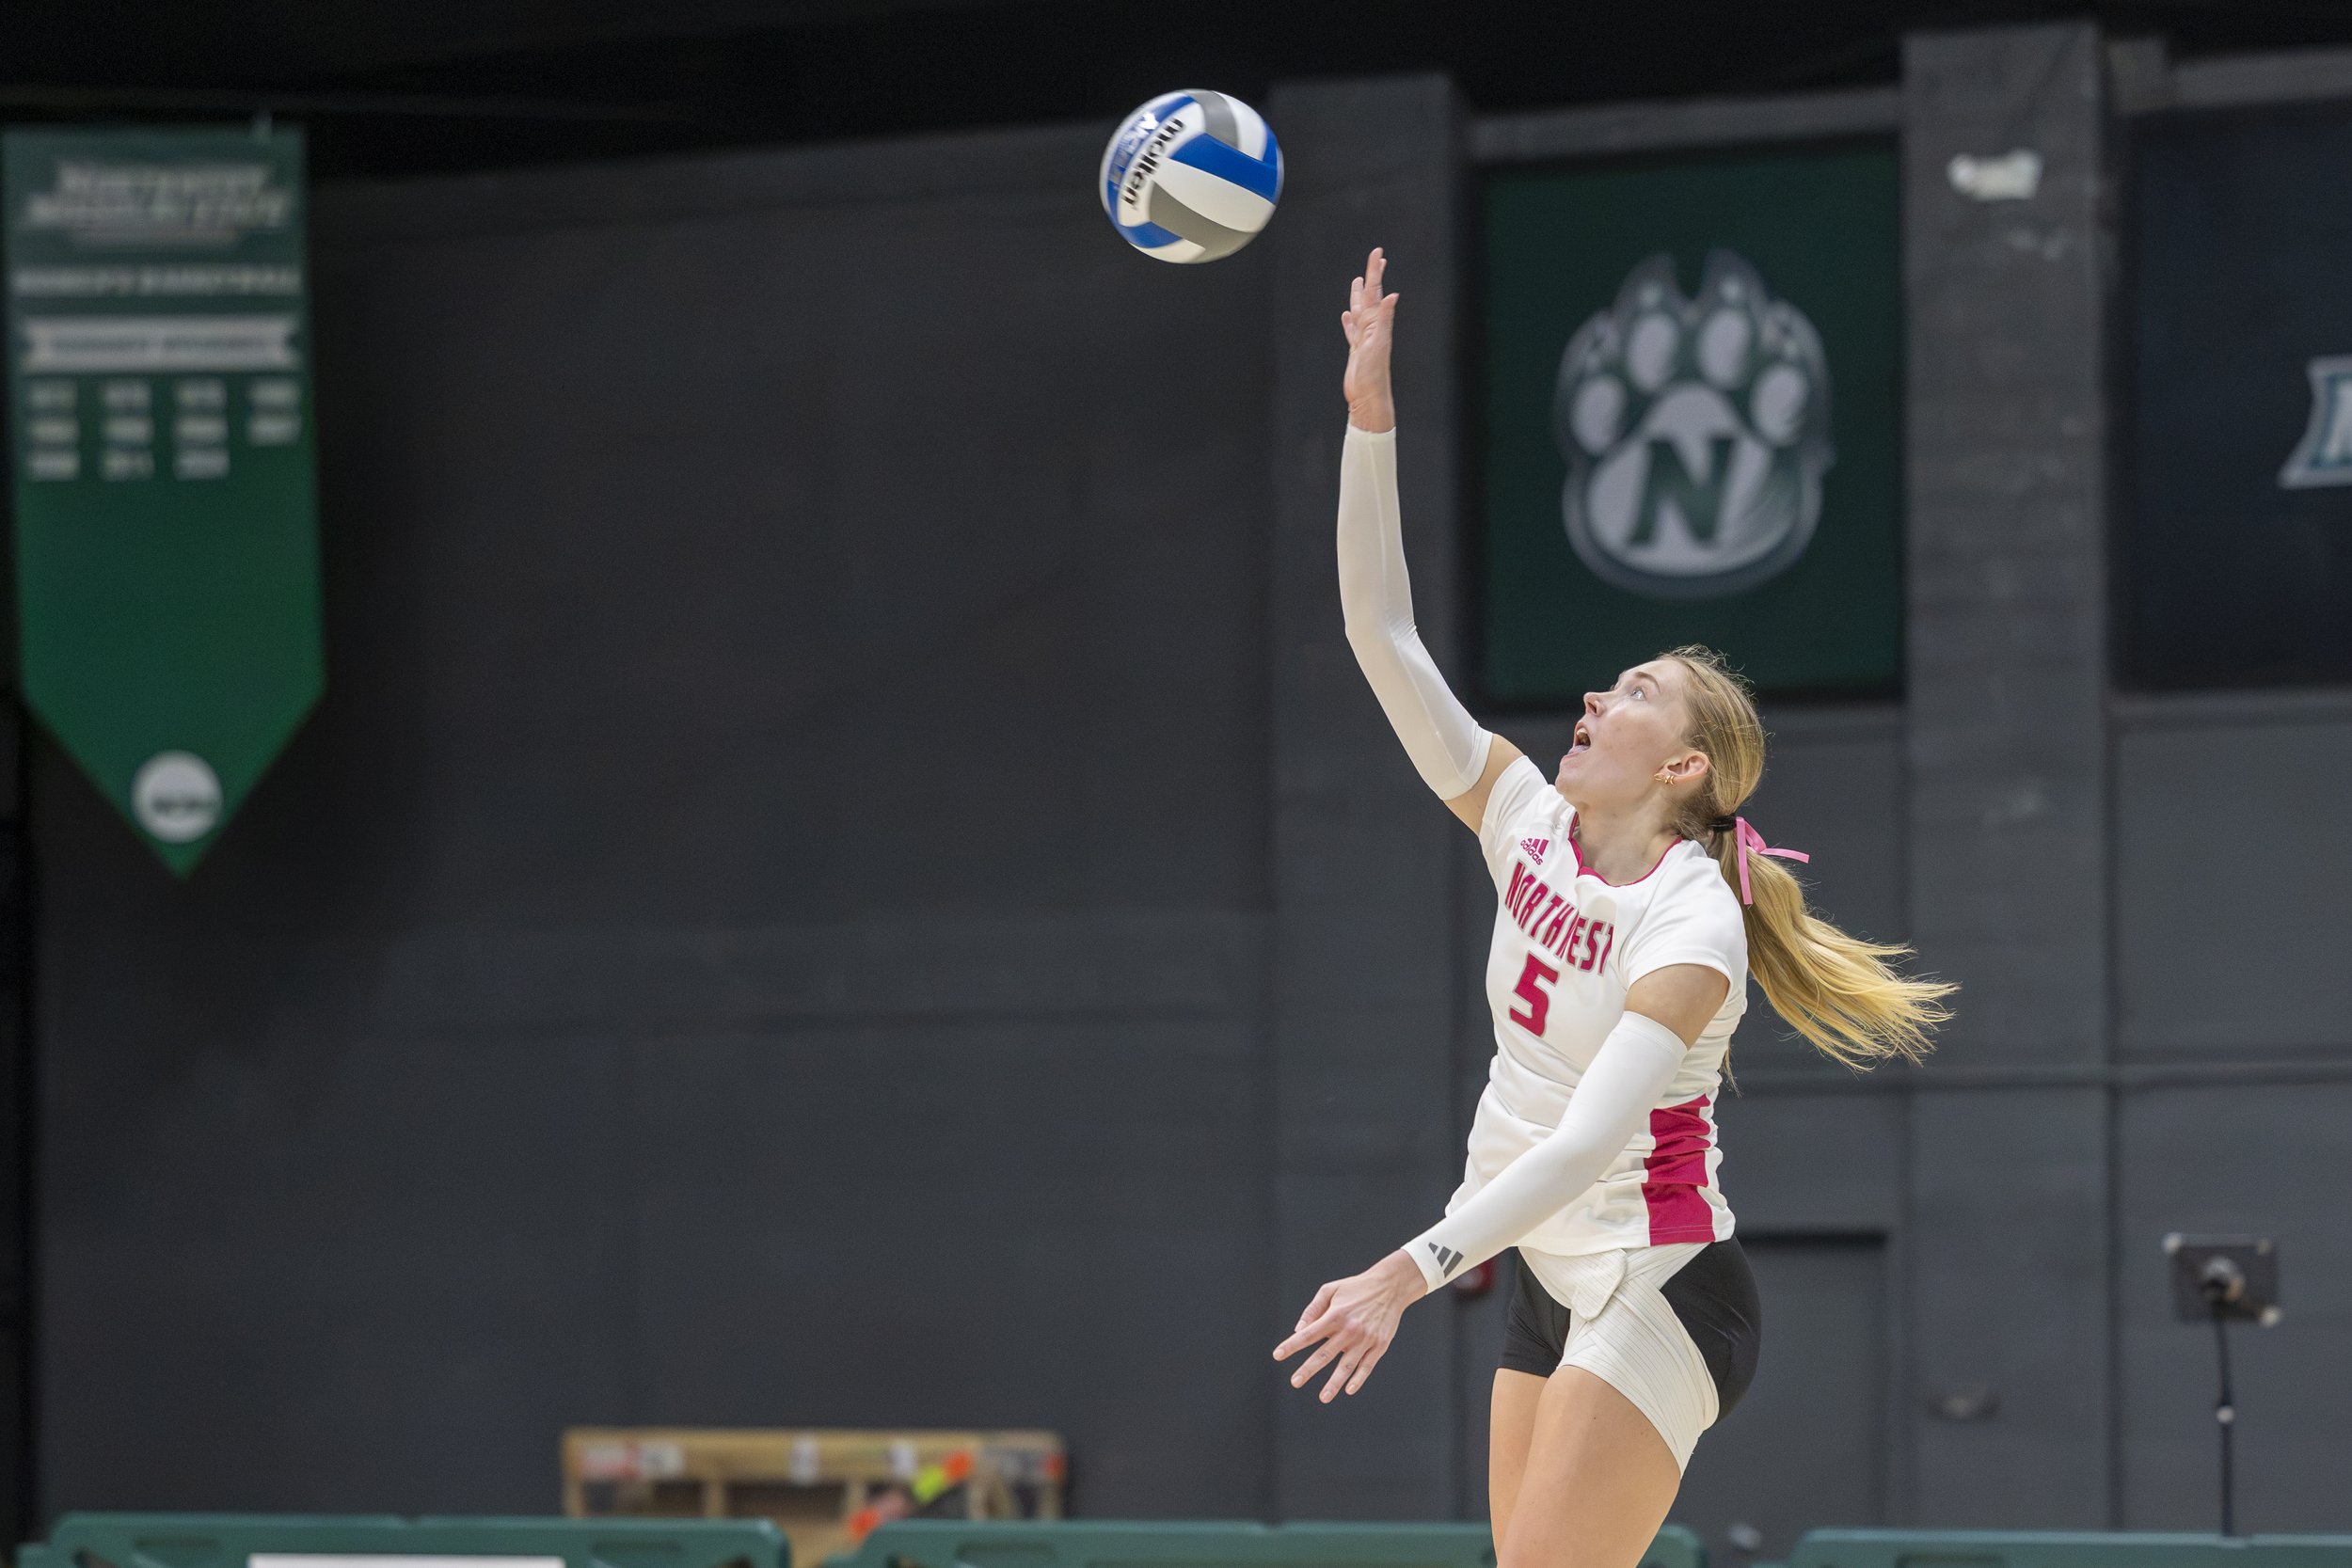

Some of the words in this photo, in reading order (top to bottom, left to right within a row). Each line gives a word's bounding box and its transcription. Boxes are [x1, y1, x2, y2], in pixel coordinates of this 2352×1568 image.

[1121, 117, 1185, 206] molten
[1628, 437, 1738, 549] N
[1519, 839, 1544, 865] adidas
[1509, 949, 1560, 1037] 5
